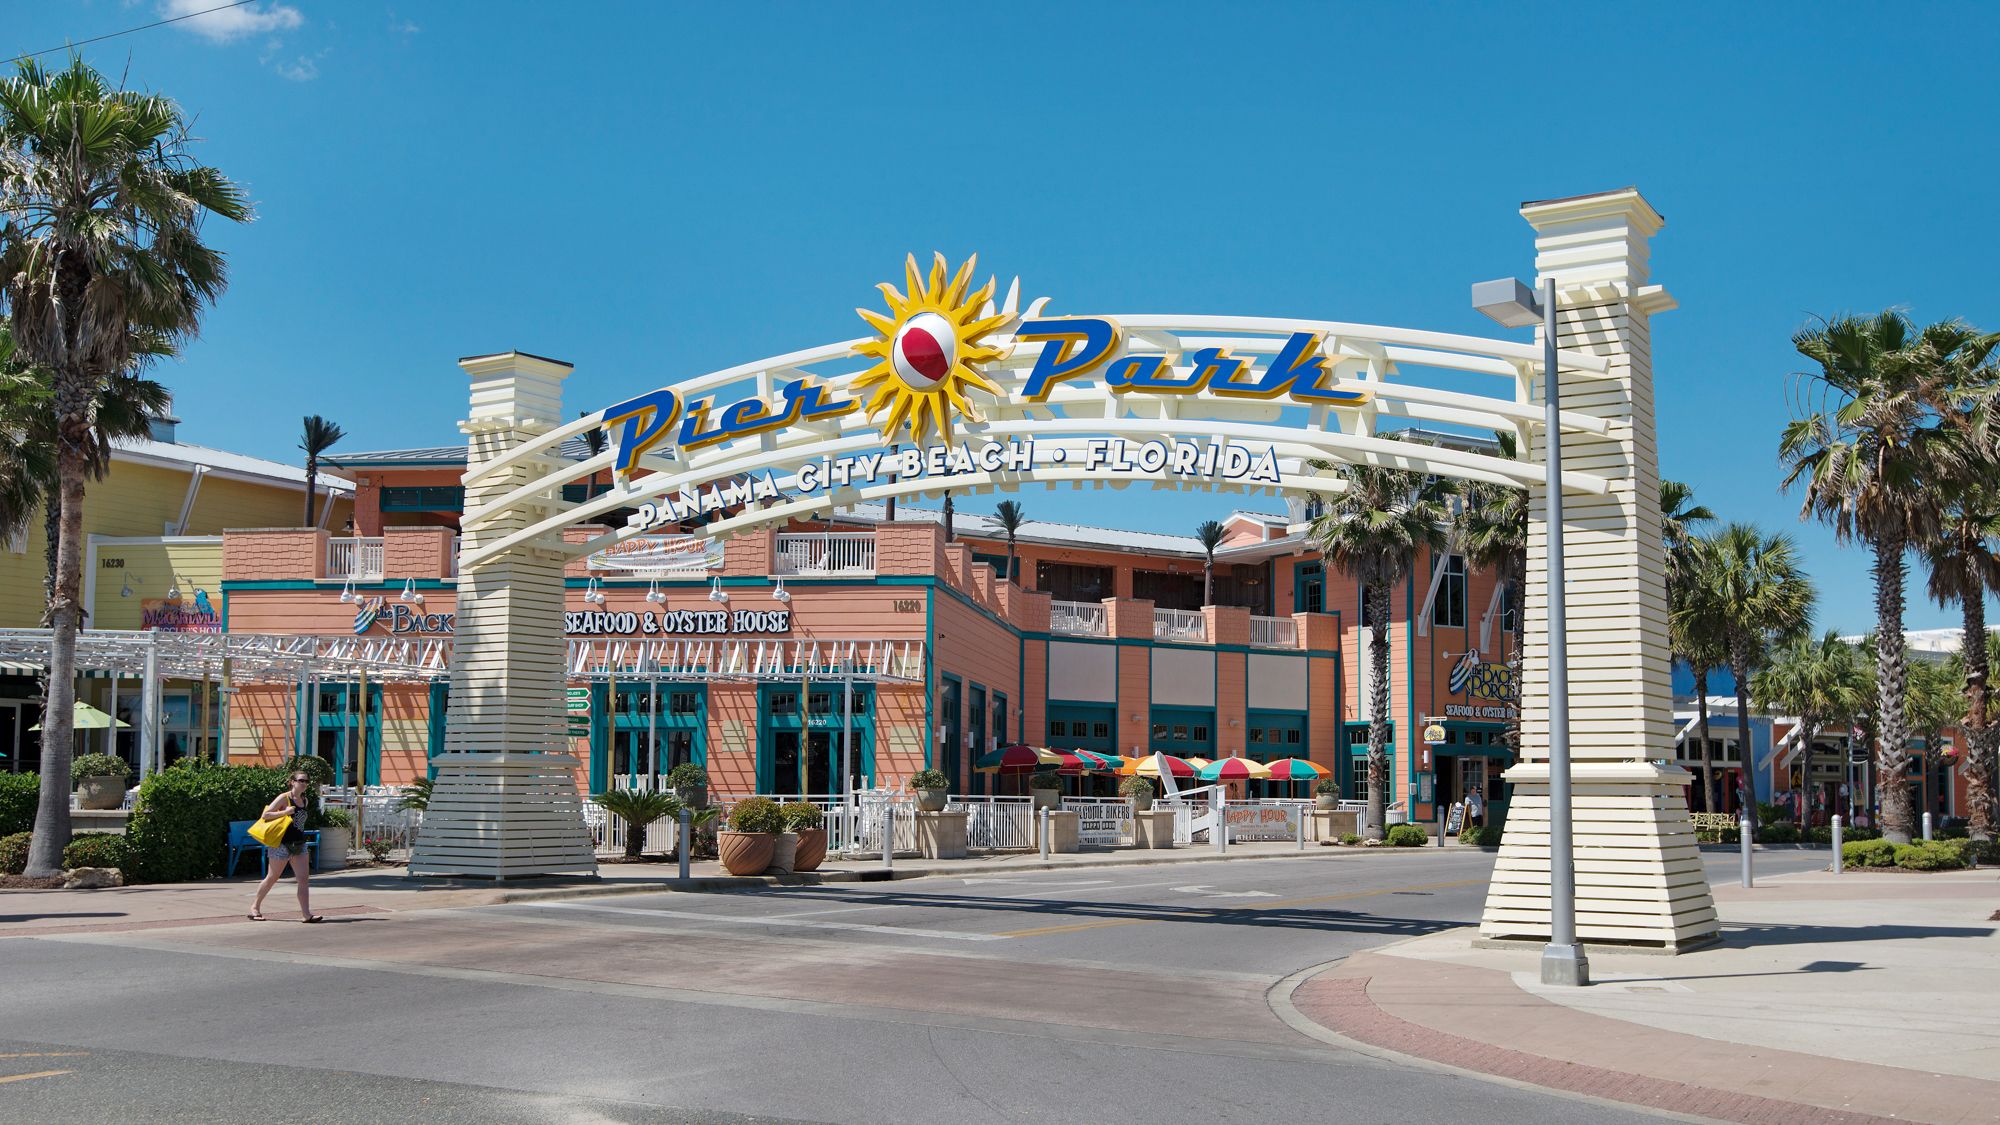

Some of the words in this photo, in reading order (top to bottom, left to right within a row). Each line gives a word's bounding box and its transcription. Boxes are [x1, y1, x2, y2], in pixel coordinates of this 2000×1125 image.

[601, 379, 862, 475] Pier
[1015, 317, 1375, 406] Park
[639, 469, 779, 531] PANAMA
[796, 452, 883, 493] CITY
[902, 440, 1034, 478] BEACH
[1086, 439, 1281, 484] FLORIDA
[663, 539, 707, 554] HOUR
[102, 559, 125, 569] 16230
[375, 605, 392, 619] the
[392, 604, 455, 633] BACK
[565, 610, 639, 634] SEAFOOD
[642, 611, 659, 633] &
[662, 609, 729, 634] OYSTER
[732, 610, 790, 634] HOUSE
[1445, 704, 1474, 717] SEAFOOD
[1475, 705, 1481, 717] &
[1482, 706, 1505, 718] OYSTER
[1106, 805, 1130, 820] BIKERS
[1260, 808, 1287, 823] HOUR
